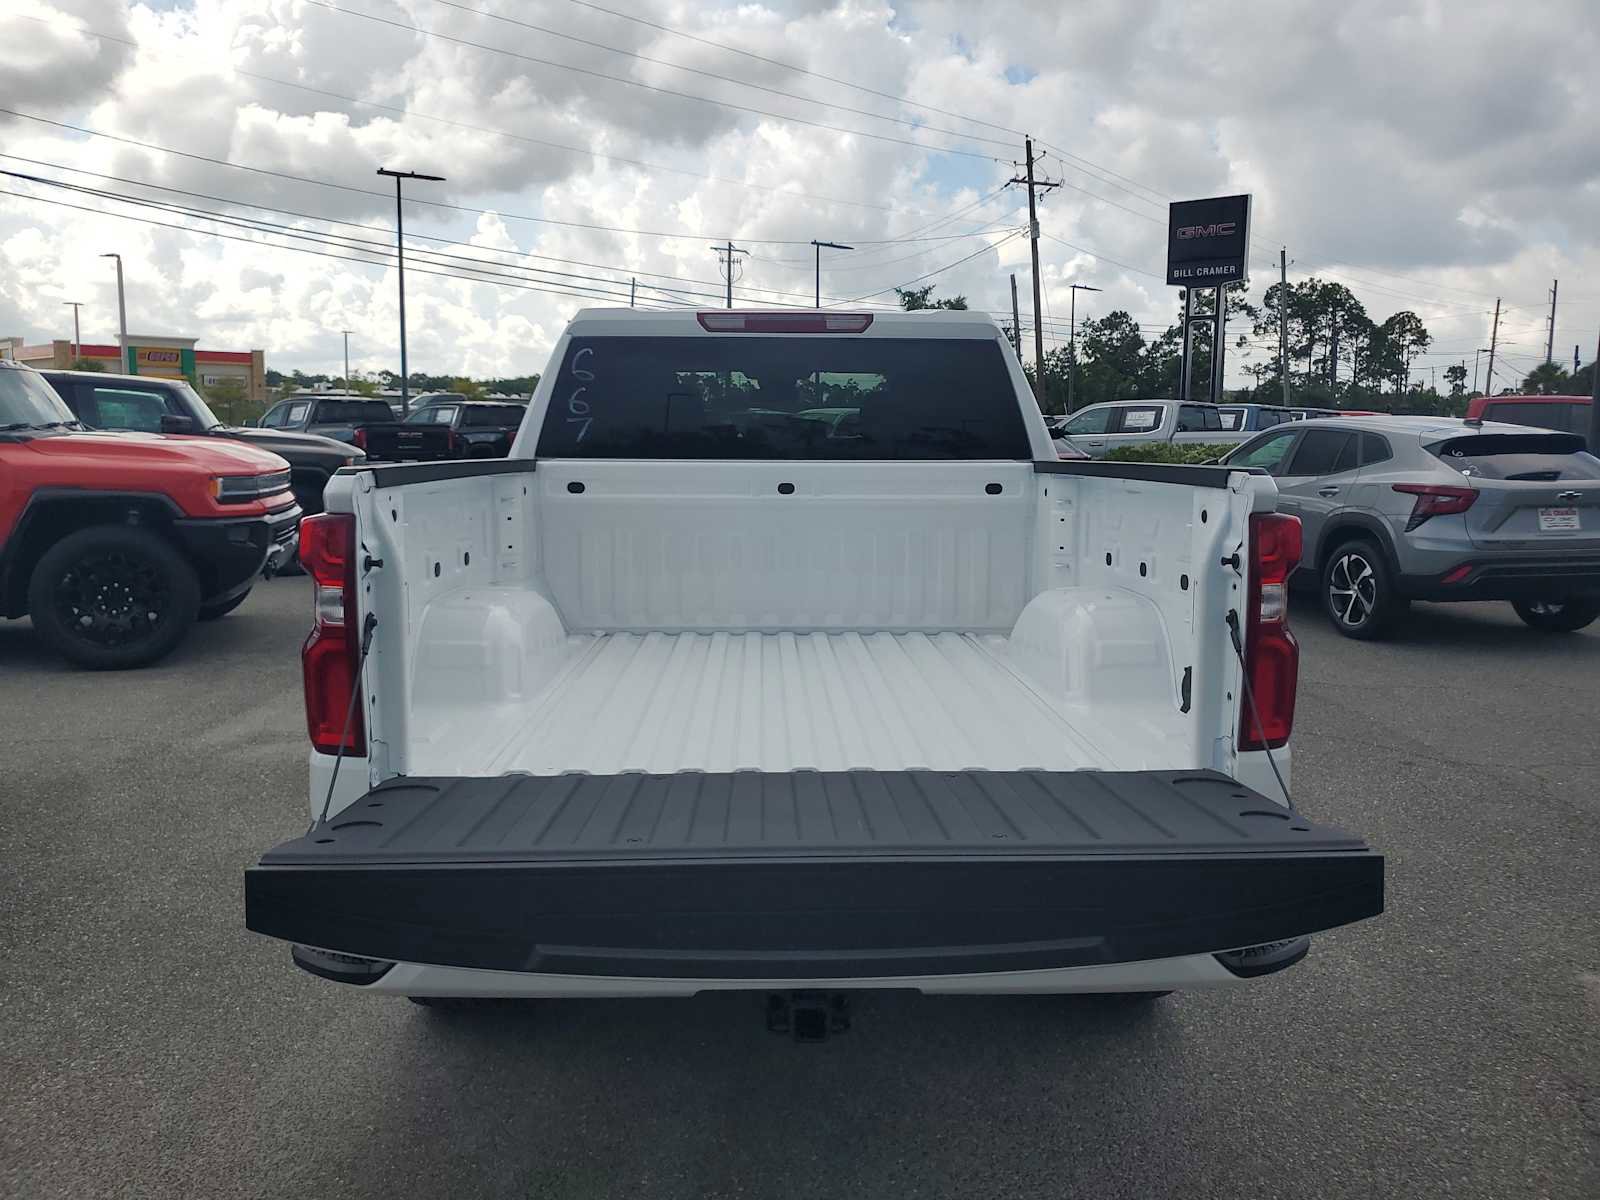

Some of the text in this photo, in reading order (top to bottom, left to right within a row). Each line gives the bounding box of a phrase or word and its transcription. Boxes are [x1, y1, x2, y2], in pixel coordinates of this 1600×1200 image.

[1176, 222, 1236, 240] GMC
[1173, 265, 1236, 278] BILL CRAMER
